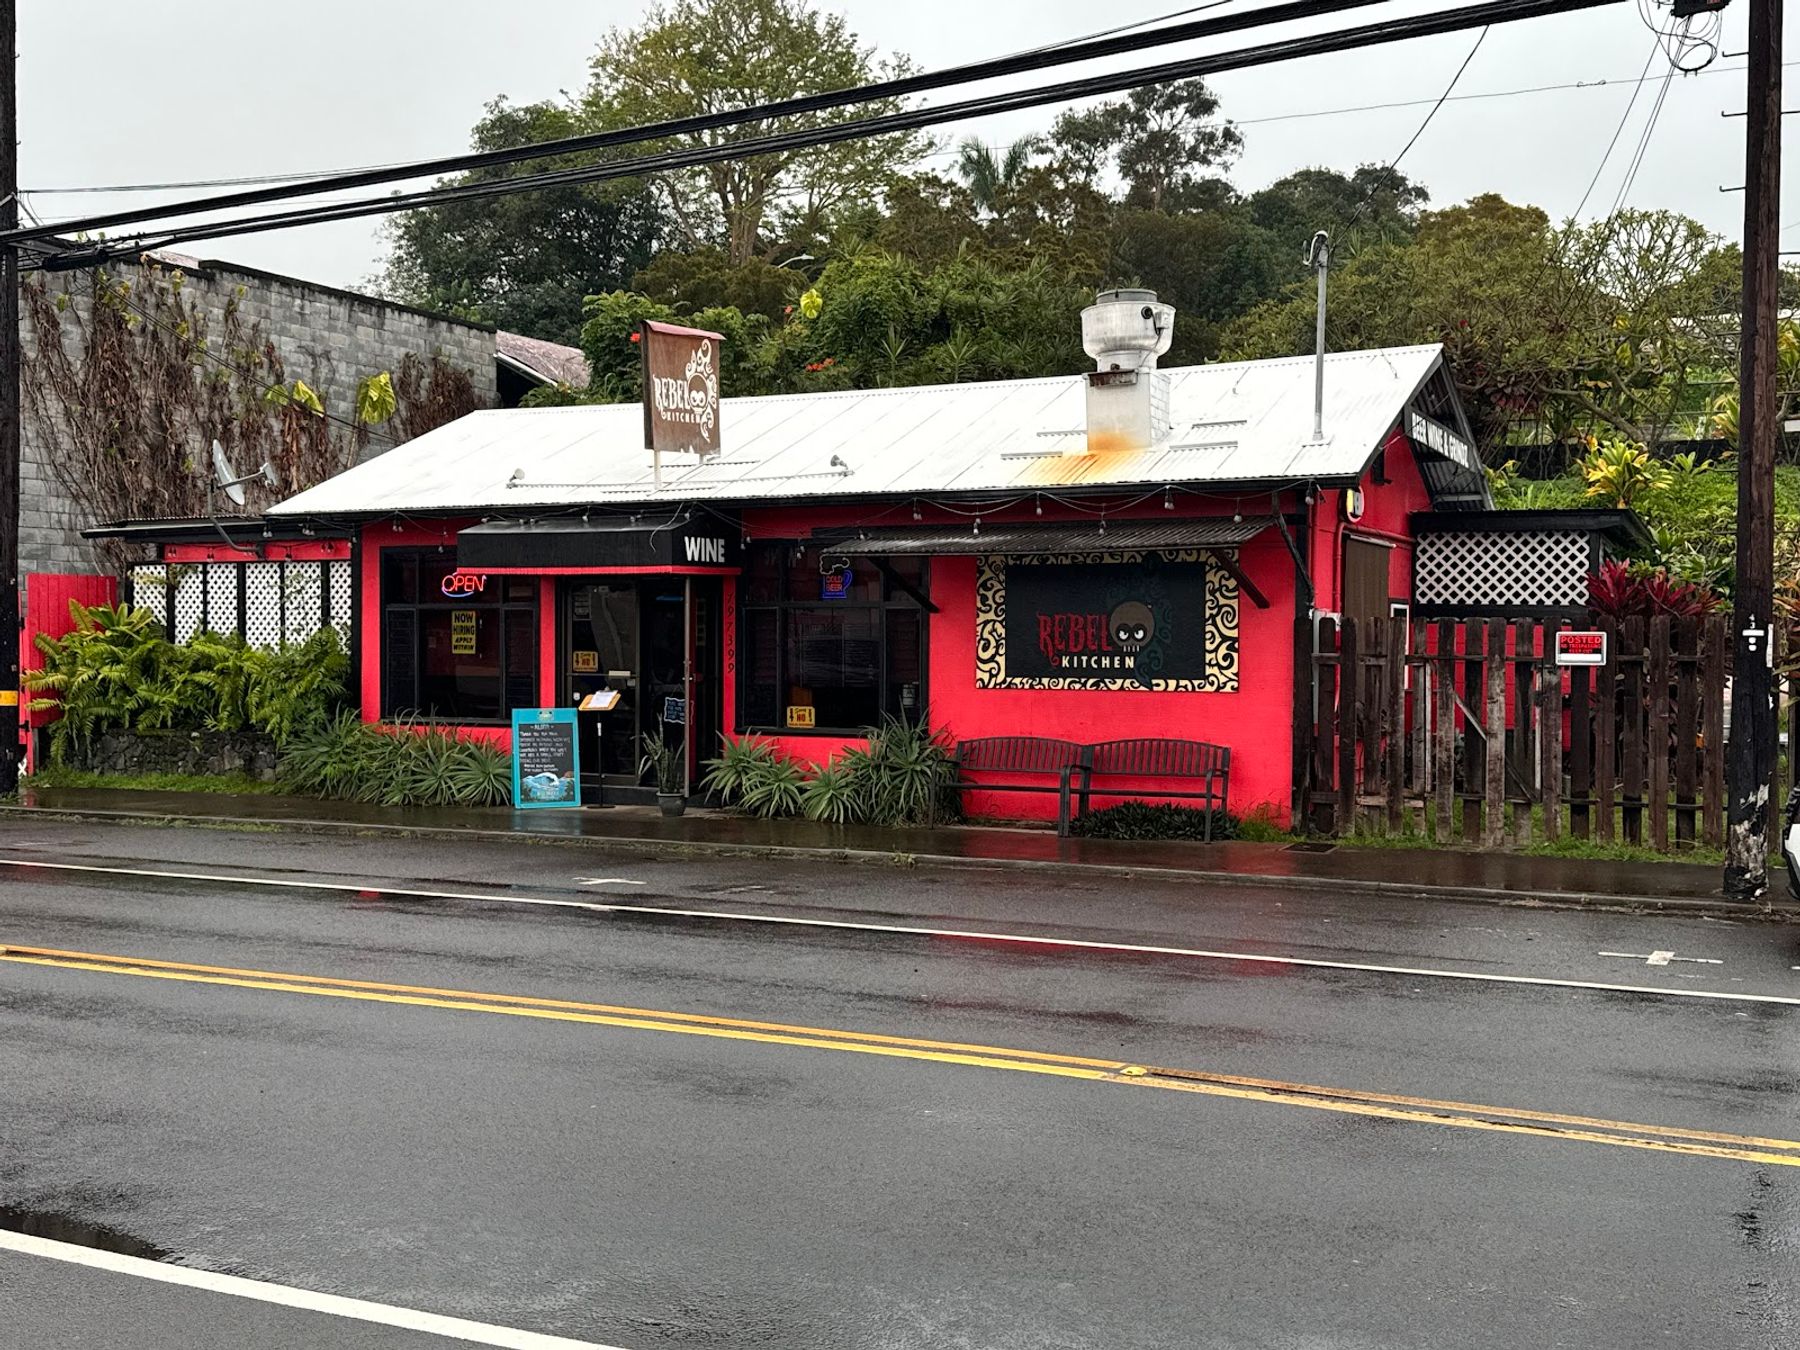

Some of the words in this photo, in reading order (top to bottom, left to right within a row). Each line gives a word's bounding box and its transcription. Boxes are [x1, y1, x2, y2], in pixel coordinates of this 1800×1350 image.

[653, 374, 690, 417] REBEL
[667, 412, 700, 423] KITCHEN
[684, 536, 725, 563] WINE
[442, 575, 487, 592] OPEN
[454, 613, 473, 624] NOW
[453, 624, 475, 636] HIRING
[455, 636, 473, 644] APPLY
[1036, 610, 1113, 667] REBEL
[1560, 636, 1601, 644] POSTED
[1061, 655, 1135, 669] KITCHEN
